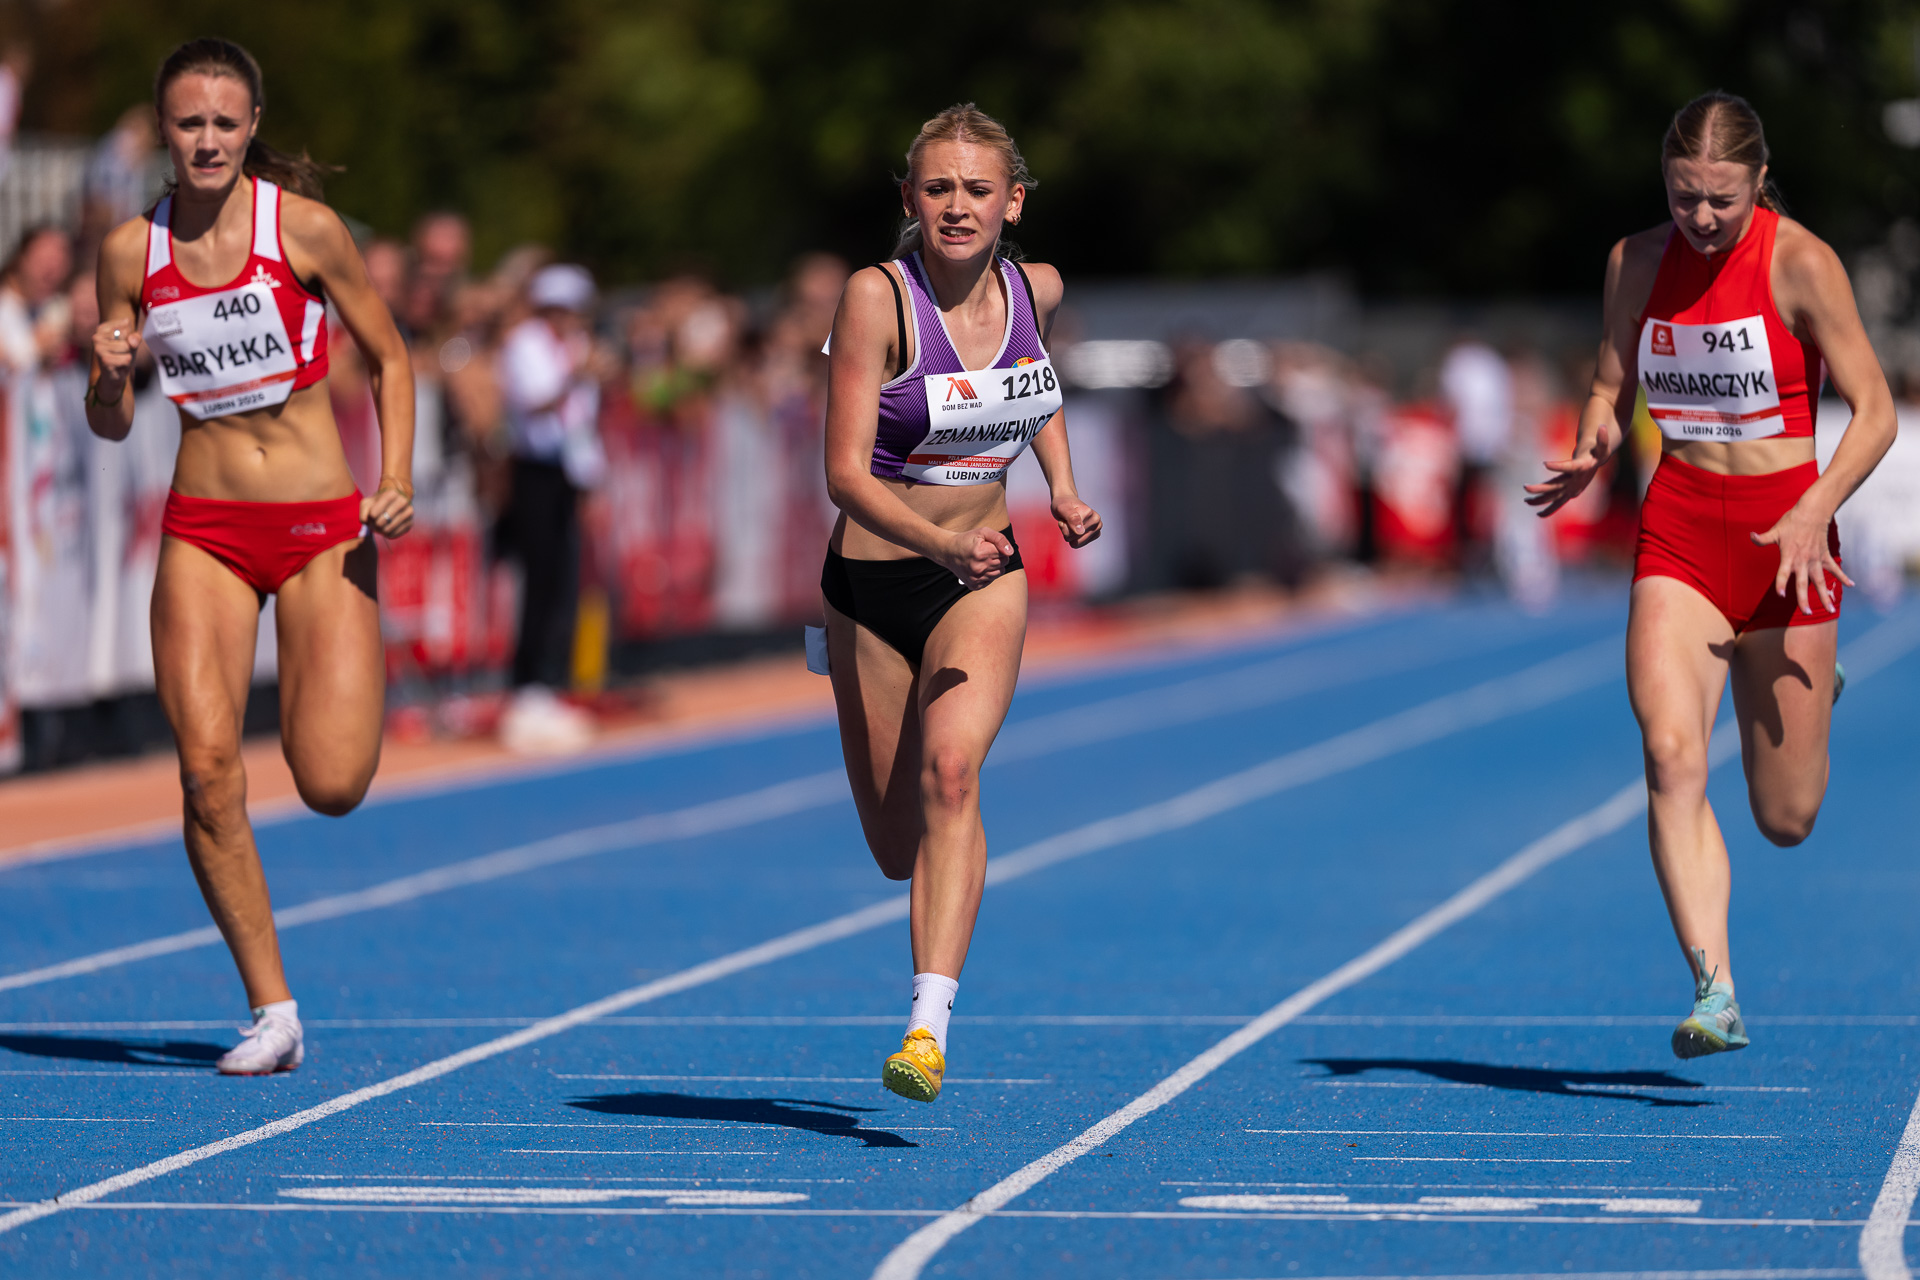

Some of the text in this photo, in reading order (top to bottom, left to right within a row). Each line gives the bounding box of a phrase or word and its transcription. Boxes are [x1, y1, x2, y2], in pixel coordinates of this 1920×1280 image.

[213, 293, 261, 321] 440
[1702, 327, 1753, 353] 941
[160, 332, 285, 377] BARYŁKA
[1002, 366, 1056, 401] 1218
[1644, 370, 1769, 398] MISIARCZYK
[203, 400, 236, 414] LUBIN
[957, 402, 968, 410] BEZ
[1682, 425, 1742, 436] LUBIN 2026
[946, 470, 980, 480] LUBIN
